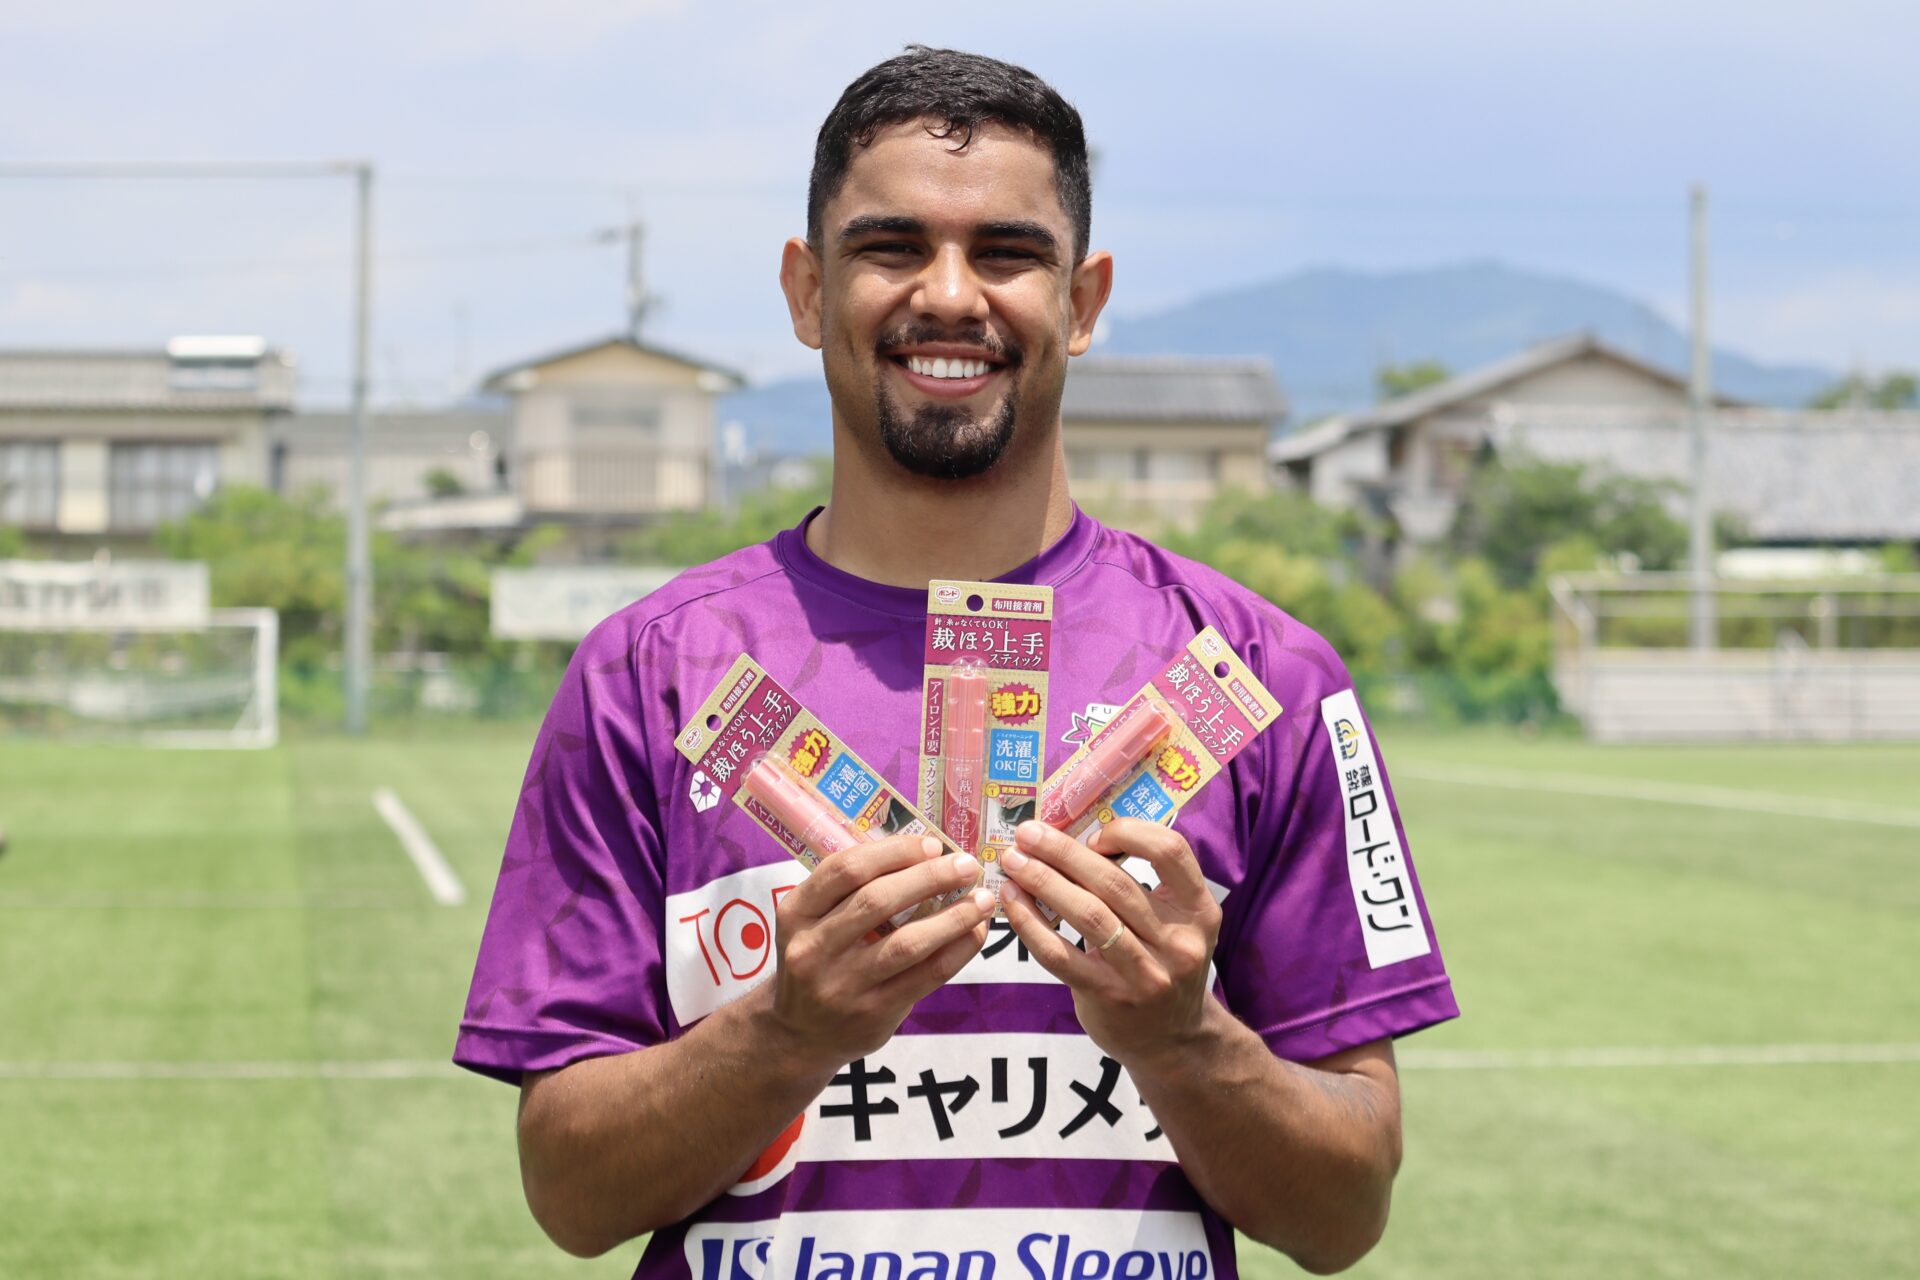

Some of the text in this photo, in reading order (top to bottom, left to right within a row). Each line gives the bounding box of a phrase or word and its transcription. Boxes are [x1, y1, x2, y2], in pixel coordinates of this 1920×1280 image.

[994, 600, 1043, 613] 布用接着剤
[931, 627, 1045, 655] 裁ほう上手
[989, 653, 1042, 667] スティック
[722, 670, 755, 711] 布用接着剤
[991, 691, 1040, 717] 強力
[1165, 662, 1244, 746] 裁ほう上手
[1231, 680, 1265, 719] 布用接着剤
[760, 704, 792, 750] スティック
[926, 680, 943, 753] アイロン不要
[1189, 716, 1227, 755] スティック
[711, 689, 783, 783] 裁ほう上手
[790, 728, 829, 777] 強力
[996, 739, 1033, 758] 洗濯
[827, 763, 859, 801] 洗濯
[994, 760, 1017, 771] OK!
[1157, 746, 1200, 790] 強力
[1345, 768, 1361, 793] 会社
[1359, 763, 1373, 788] 有限
[842, 788, 861, 809] OK!
[1131, 783, 1164, 818] 洗濯
[820, 1056, 1164, 1142] キャリメ
